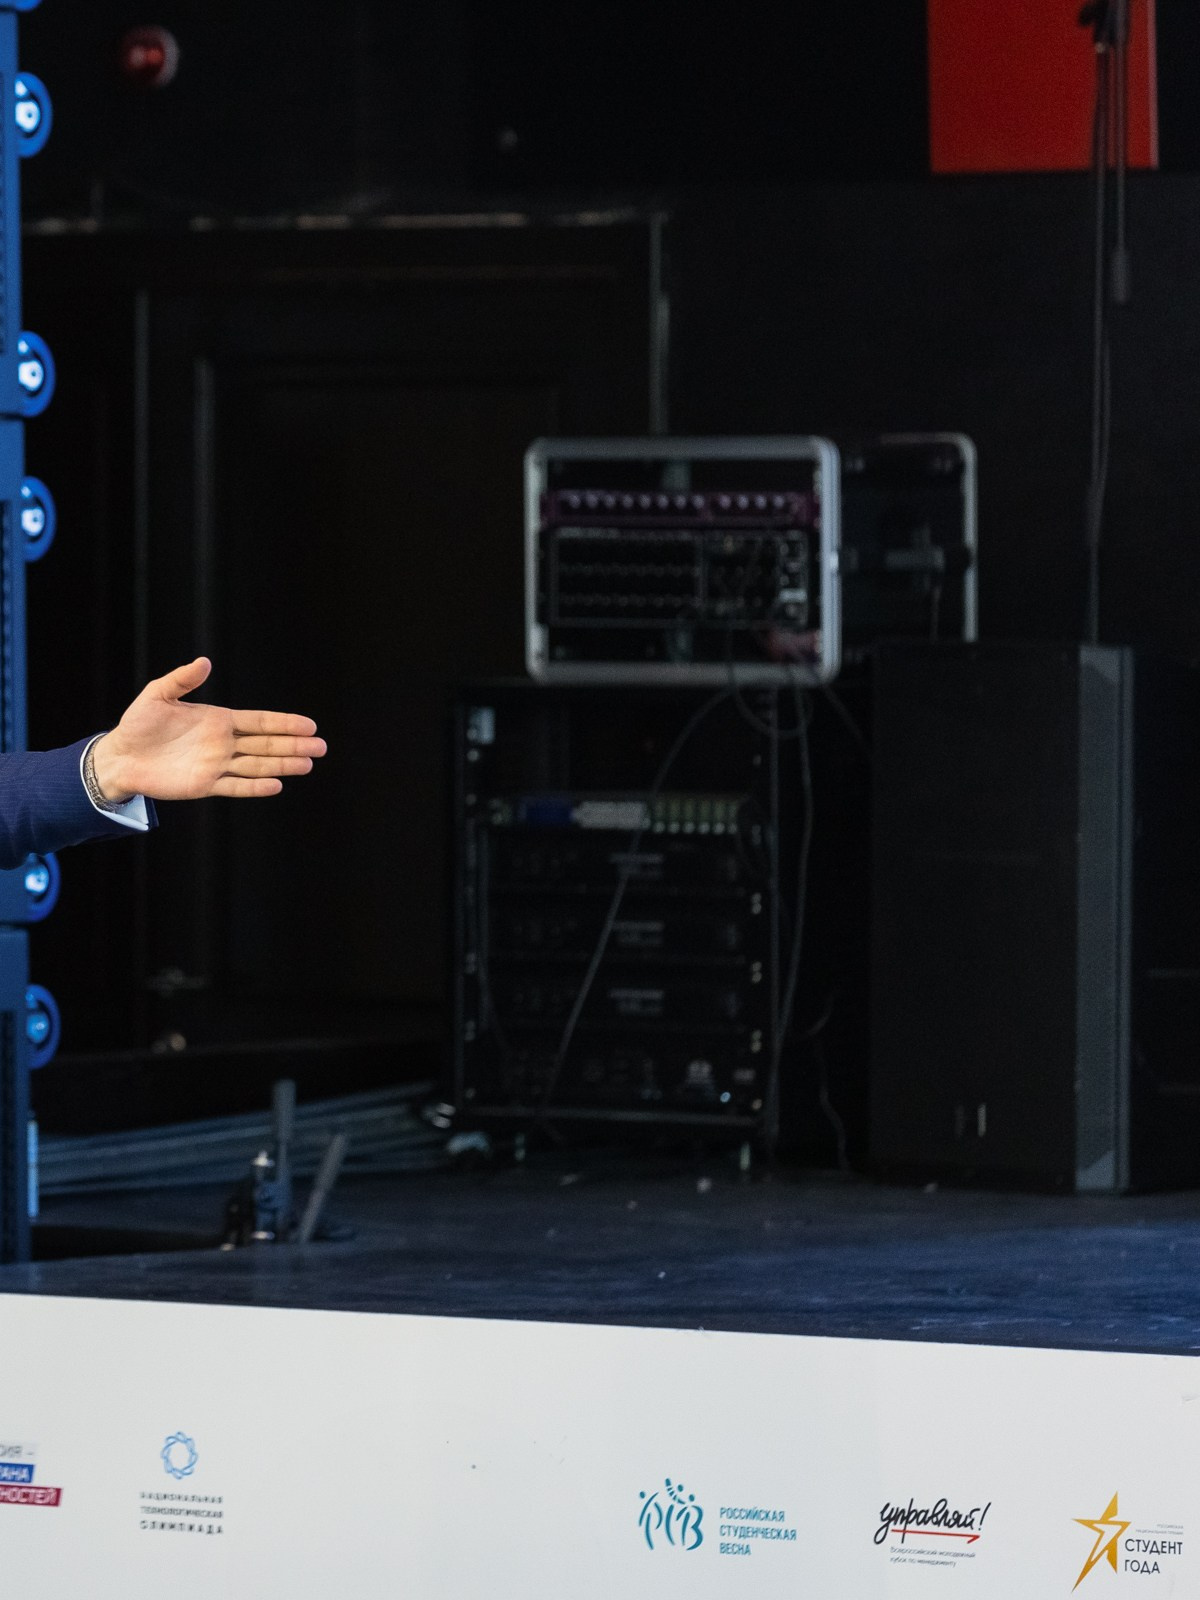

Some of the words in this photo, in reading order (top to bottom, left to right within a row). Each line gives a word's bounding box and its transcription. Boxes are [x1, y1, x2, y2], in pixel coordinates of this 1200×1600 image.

[719, 1506, 786, 1522] РОССИЙСКАЯ
[719, 1524, 798, 1540] СТУДЕНЧЕСКАЯ
[719, 1542, 751, 1556] ВЕСНА
[1124, 1538, 1183, 1555] СТУДЕНТ
[1124, 1559, 1161, 1575] ГОДА
